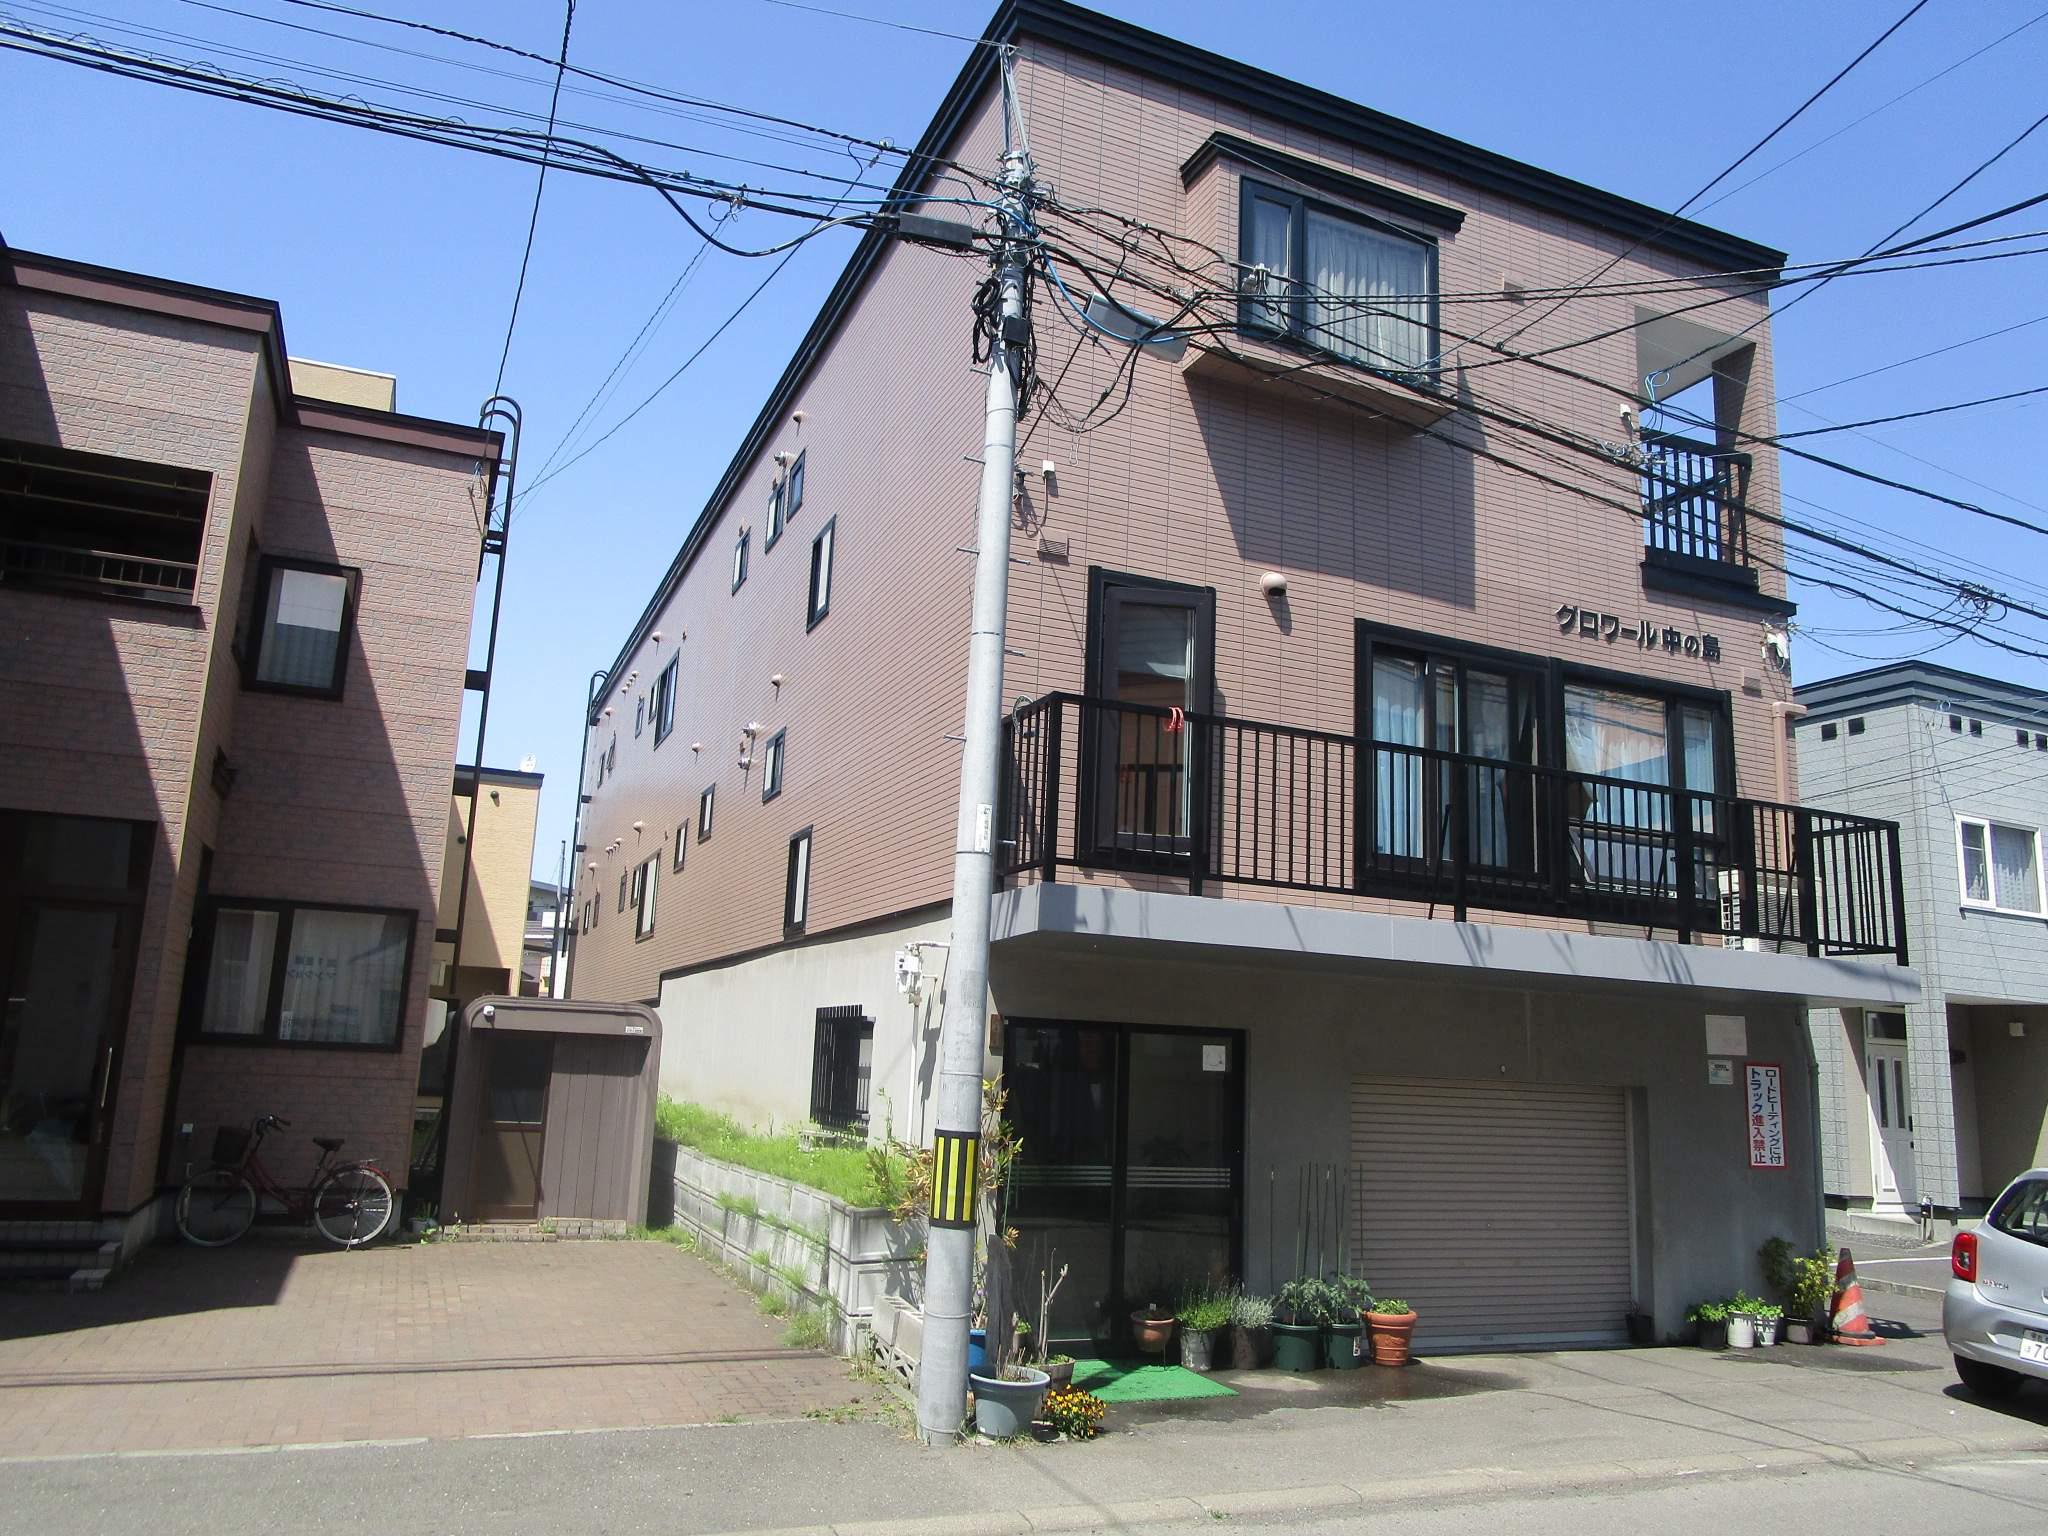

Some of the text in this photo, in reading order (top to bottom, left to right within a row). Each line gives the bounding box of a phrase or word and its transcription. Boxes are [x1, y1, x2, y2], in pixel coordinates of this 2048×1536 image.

[1751, 1068, 1767, 1165] トラック進入禁止
[1766, 1069, 1782, 1165] ロードヒーティングに付
